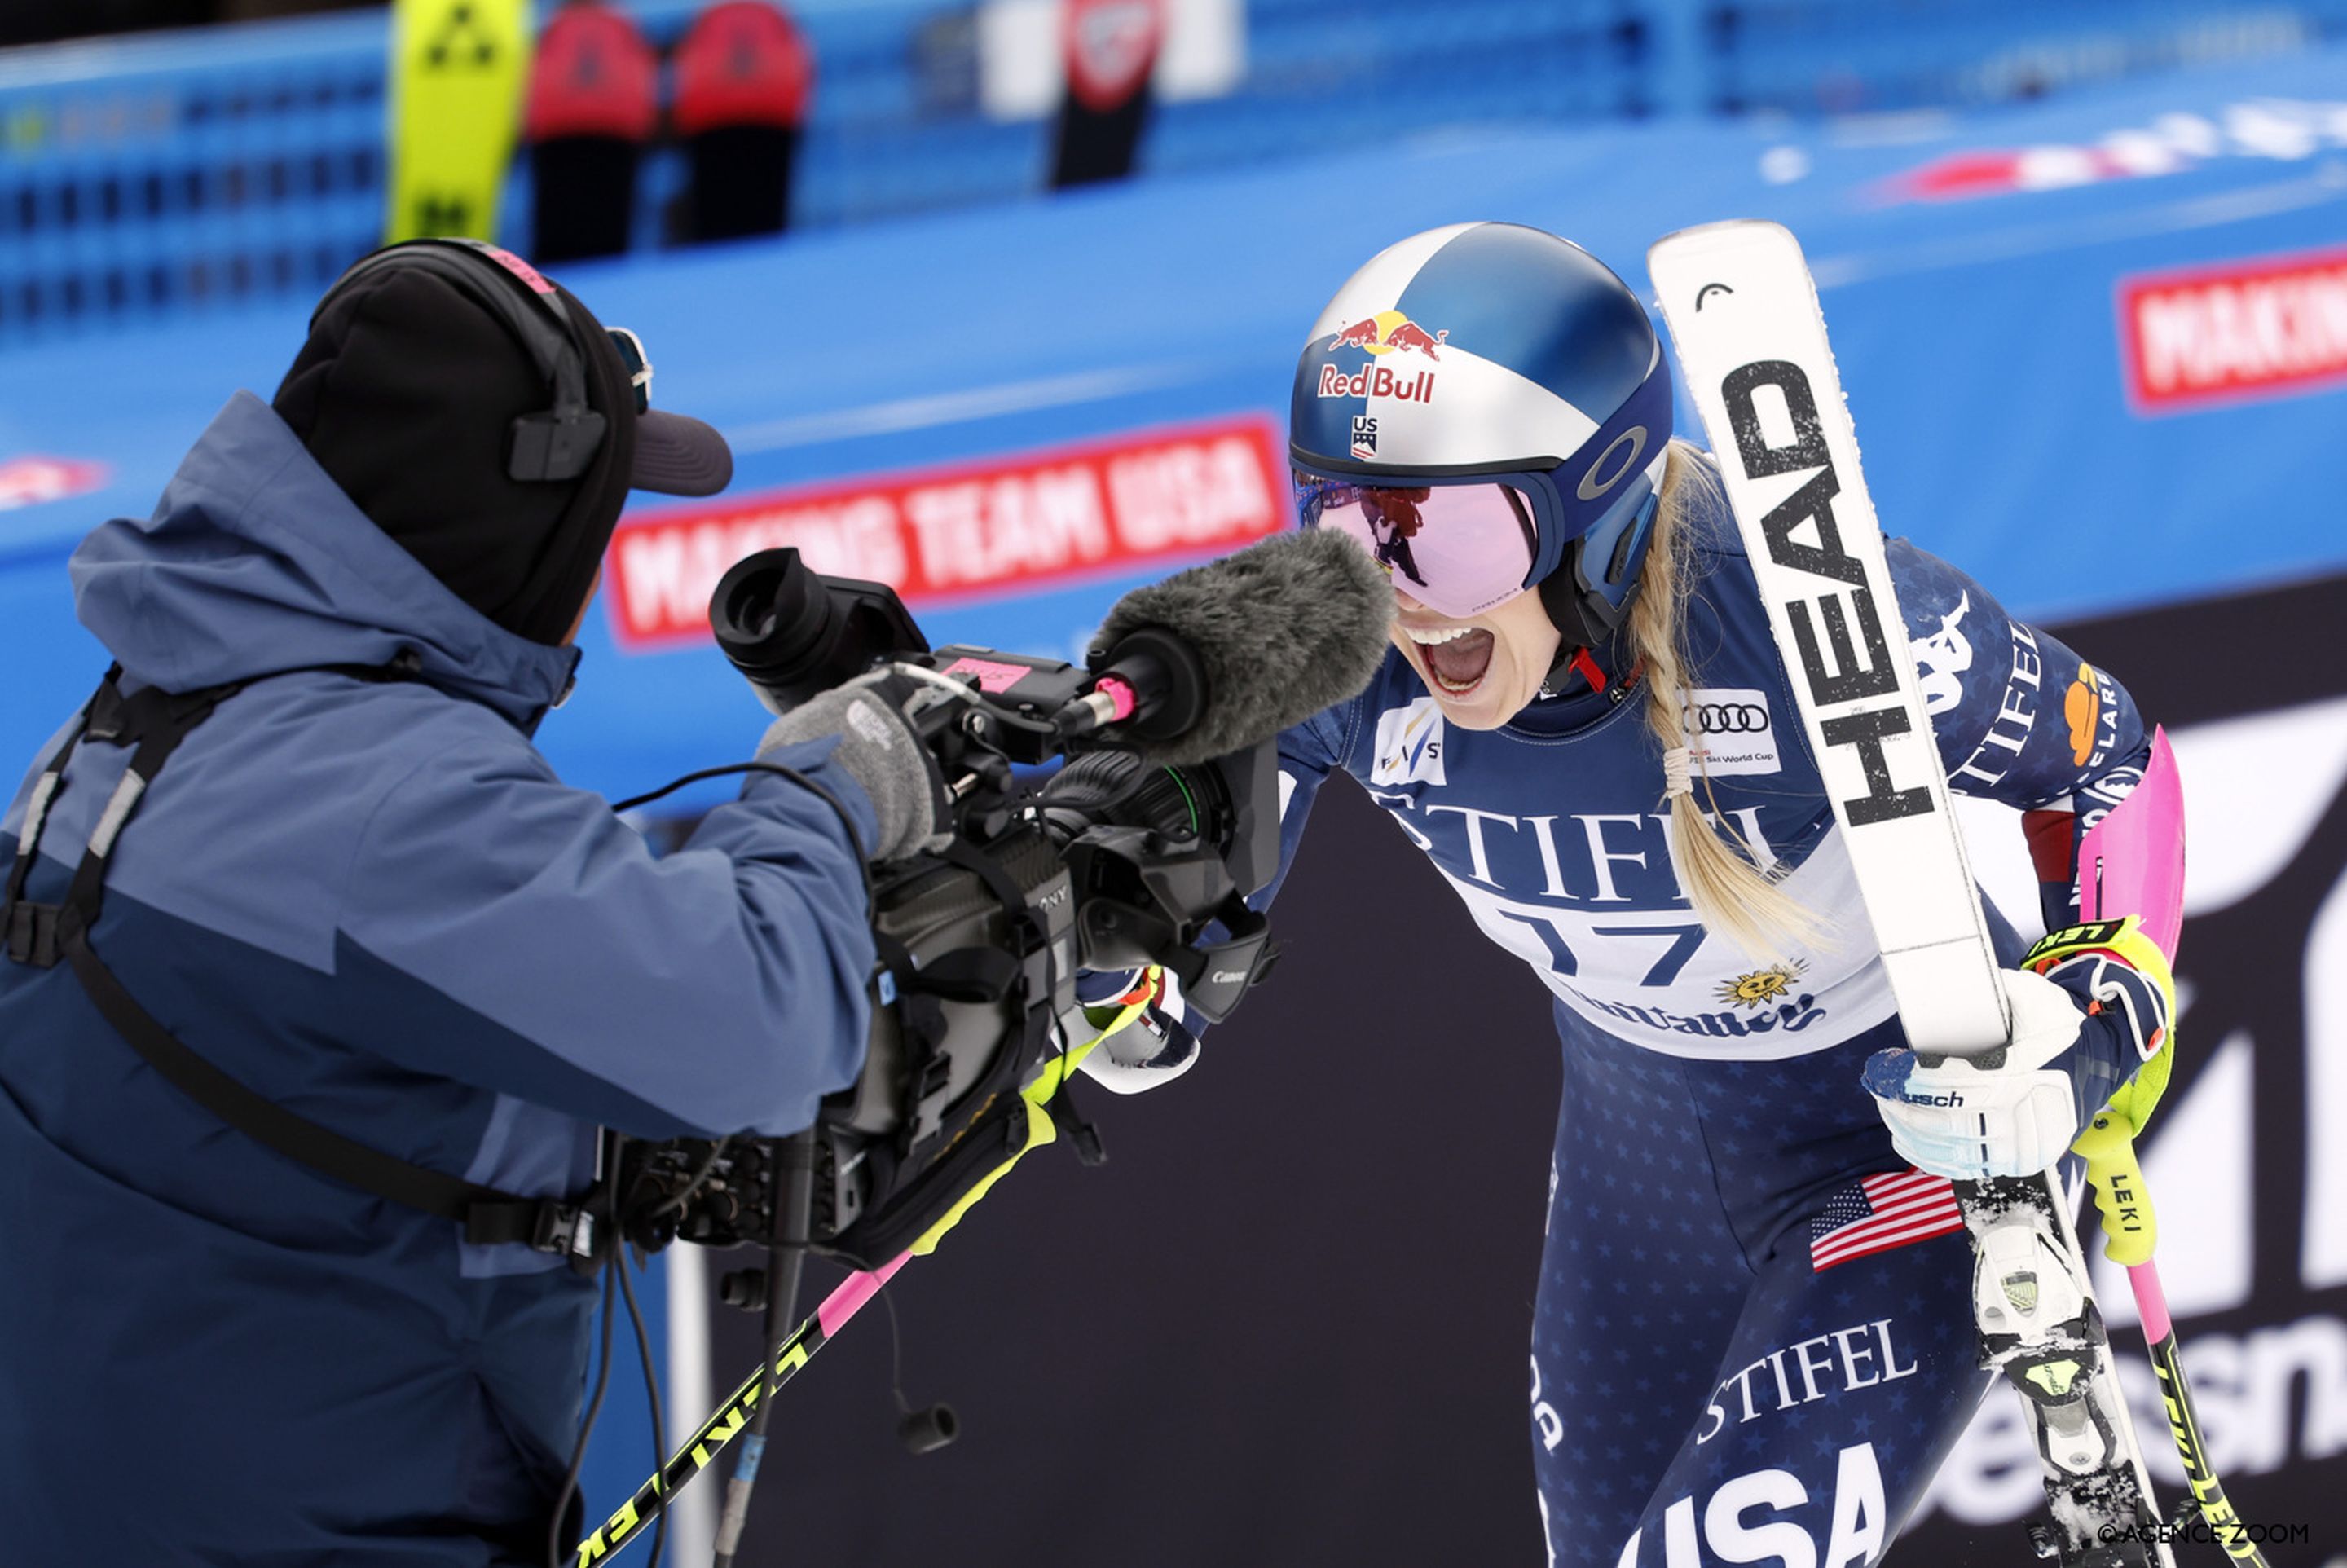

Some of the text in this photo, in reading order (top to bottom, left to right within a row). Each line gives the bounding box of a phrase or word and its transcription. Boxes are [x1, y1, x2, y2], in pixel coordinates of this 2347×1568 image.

[1319, 364, 1435, 403] Red Bull
[1354, 416, 1378, 433] US
[905, 460, 1111, 590] TEAM
[1107, 434, 1275, 552] USA
[1721, 359, 1935, 827] HEAD
[1946, 620, 2041, 796] TIFEL
[1706, 755, 1721, 764] Ski
[1723, 753, 1753, 764] World
[1755, 752, 1774, 762] Cup
[1497, 908, 1709, 988] 17
[2028, 924, 2106, 958] LEKI
[1896, 1090, 1965, 1108] usch
[2110, 1174, 2142, 1231] LEKI
[1696, 1319, 1918, 1446] STIFEL
[1617, 1441, 1887, 1568] USA
